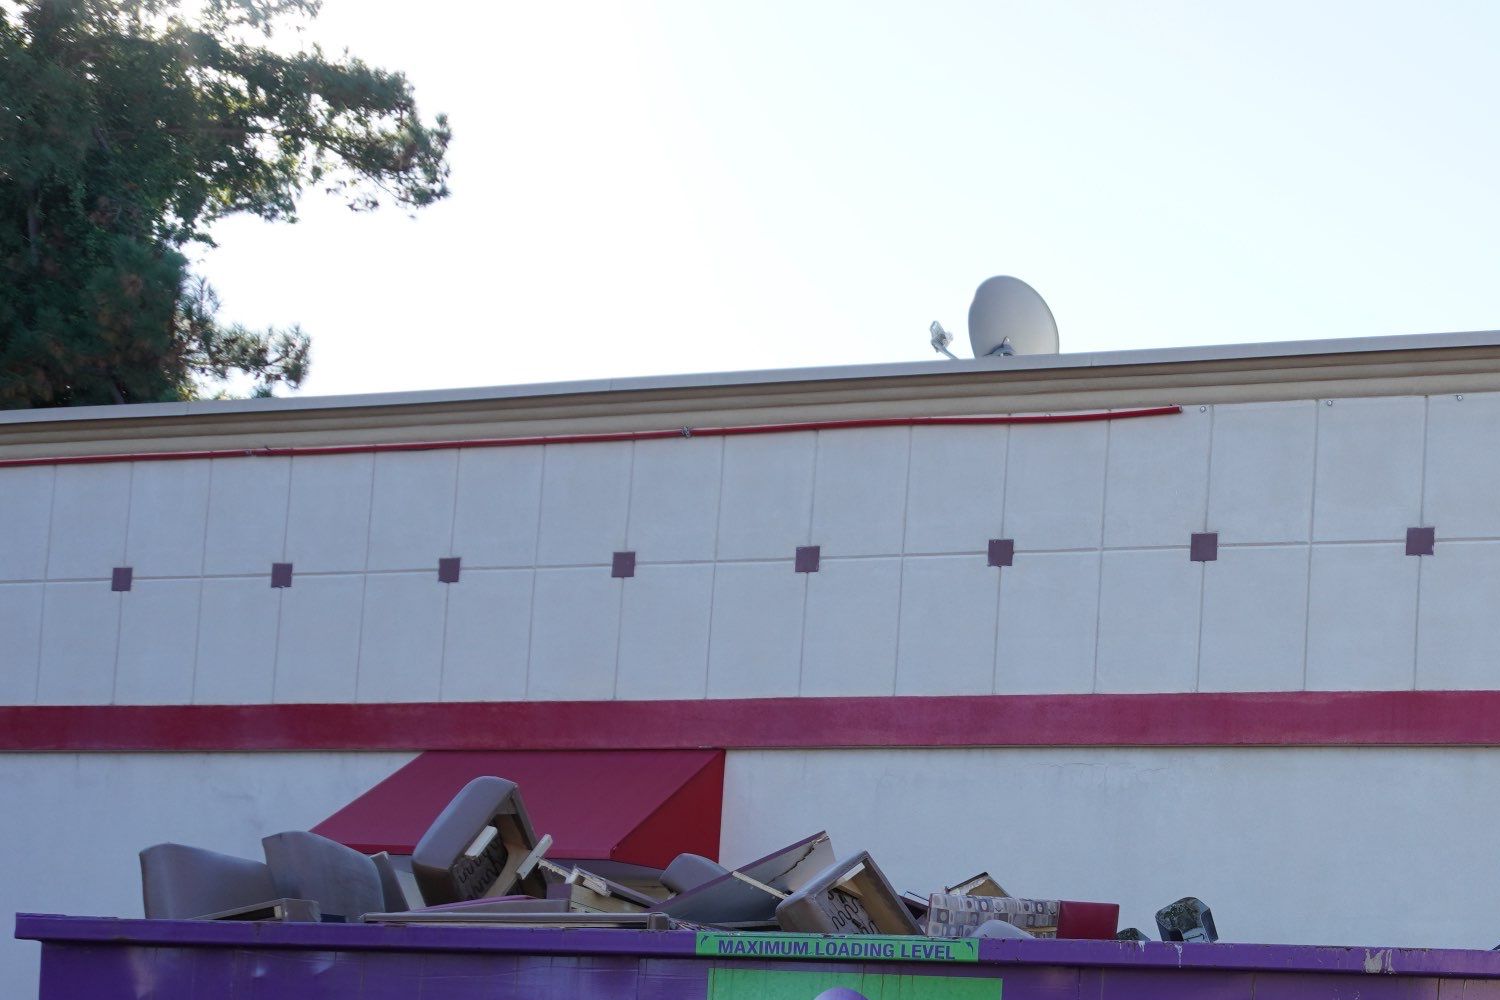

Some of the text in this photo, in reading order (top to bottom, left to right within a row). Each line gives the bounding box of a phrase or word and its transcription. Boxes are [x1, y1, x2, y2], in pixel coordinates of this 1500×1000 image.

[718, 939, 956, 961] MAXIMUM LOADING LEVEL
